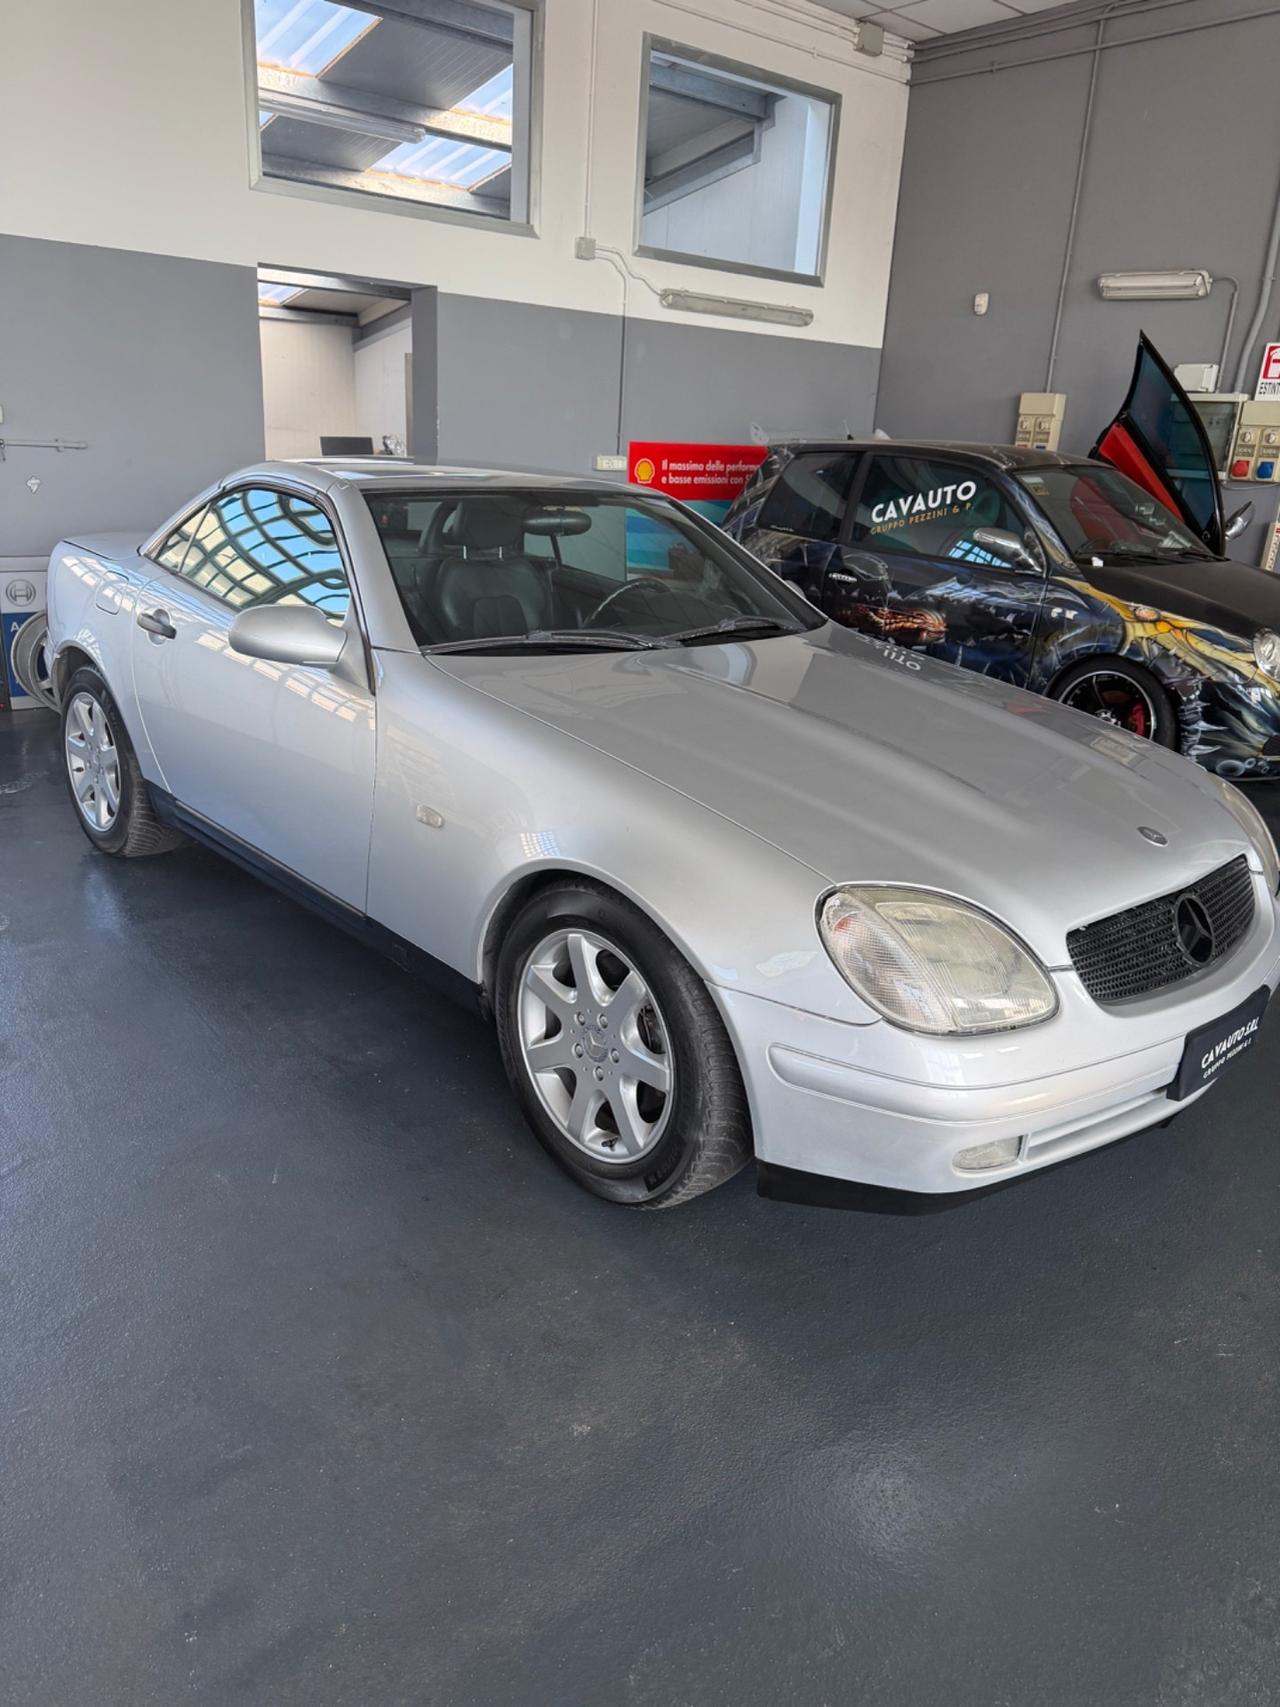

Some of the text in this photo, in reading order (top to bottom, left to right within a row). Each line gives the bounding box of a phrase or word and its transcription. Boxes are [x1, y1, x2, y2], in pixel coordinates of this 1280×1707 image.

[669, 460, 704, 471] massimo
[705, 459, 724, 471] delle
[726, 460, 760, 474] perform
[661, 475, 667, 484] e
[668, 472, 692, 485] basse
[693, 473, 729, 485] emissioni
[730, 475, 744, 485] con
[871, 480, 977, 523] CAVAUTO
[870, 519, 905, 536] GRUPPO
[1201, 1026, 1245, 1069] CAVAUTO
